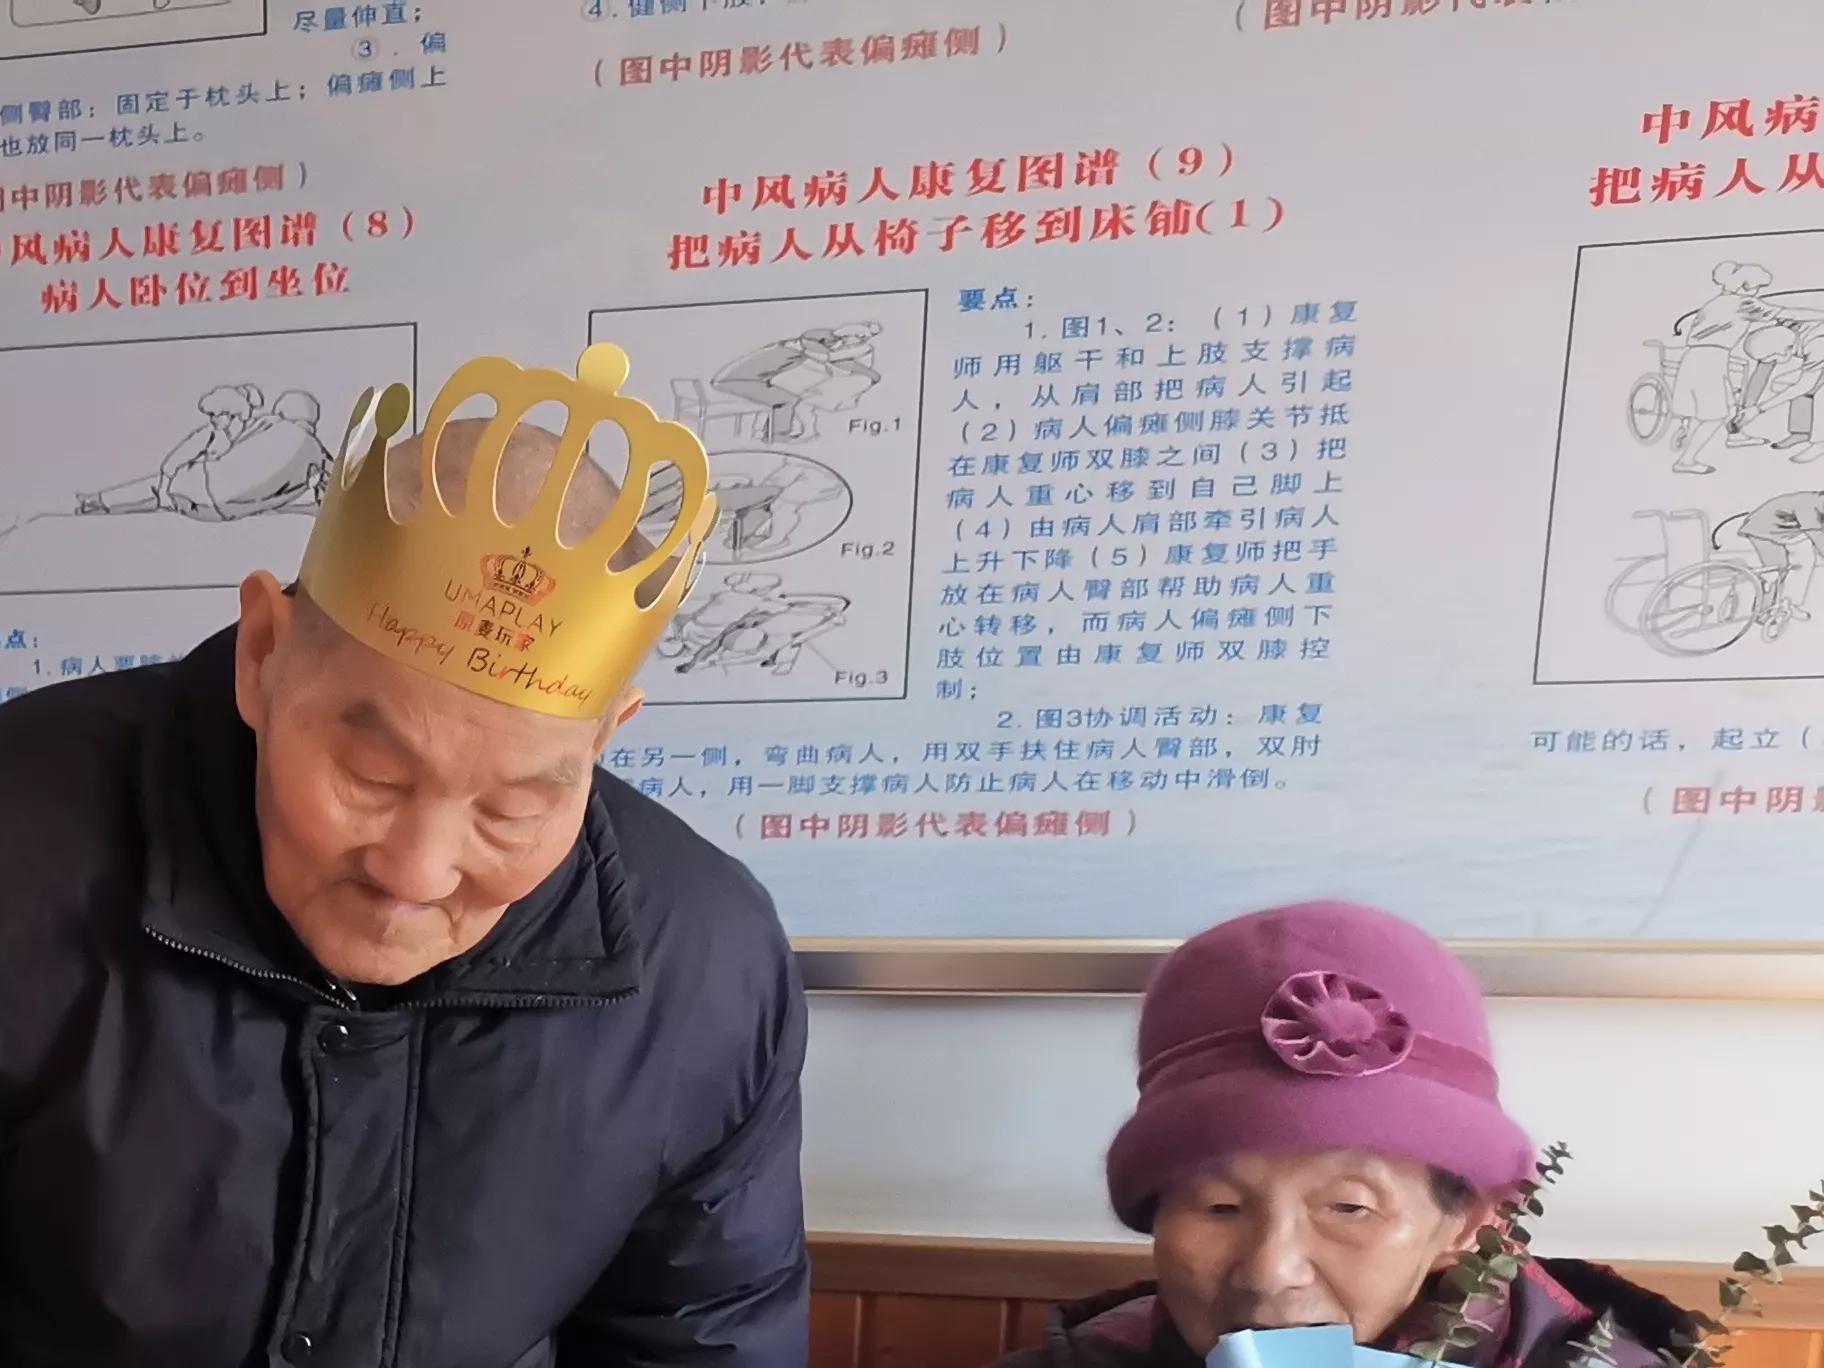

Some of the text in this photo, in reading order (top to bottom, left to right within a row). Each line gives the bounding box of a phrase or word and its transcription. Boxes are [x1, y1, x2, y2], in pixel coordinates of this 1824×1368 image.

[1641, 94, 1820, 145] 中风病
[41, 262, 350, 314] 病人卧位到坐位
[848, 417, 901, 436] Fig.1
[946, 471, 1344, 510] 病人重心移到自己脚上
[841, 541, 895, 560] Fig.2
[444, 578, 563, 637] UMAPLAY
[367, 602, 593, 706] Happy Birthday
[834, 670, 889, 688] Fig.3
